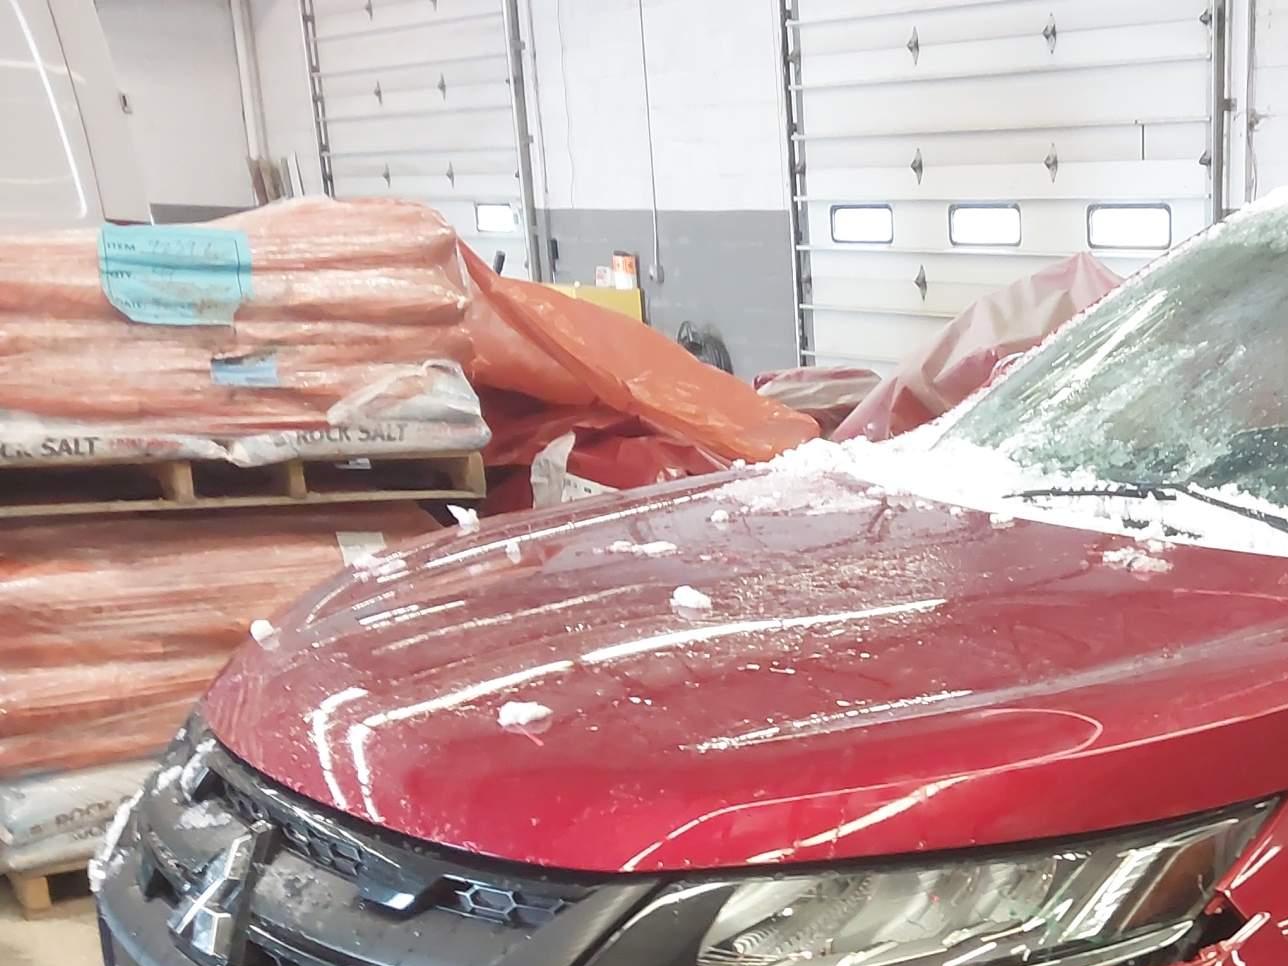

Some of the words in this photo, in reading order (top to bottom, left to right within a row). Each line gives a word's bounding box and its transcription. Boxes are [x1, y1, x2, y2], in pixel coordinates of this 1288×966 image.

[296, 425, 350, 446] ROCK
[357, 422, 409, 443] SALT
[41, 436, 99, 457] SALT
